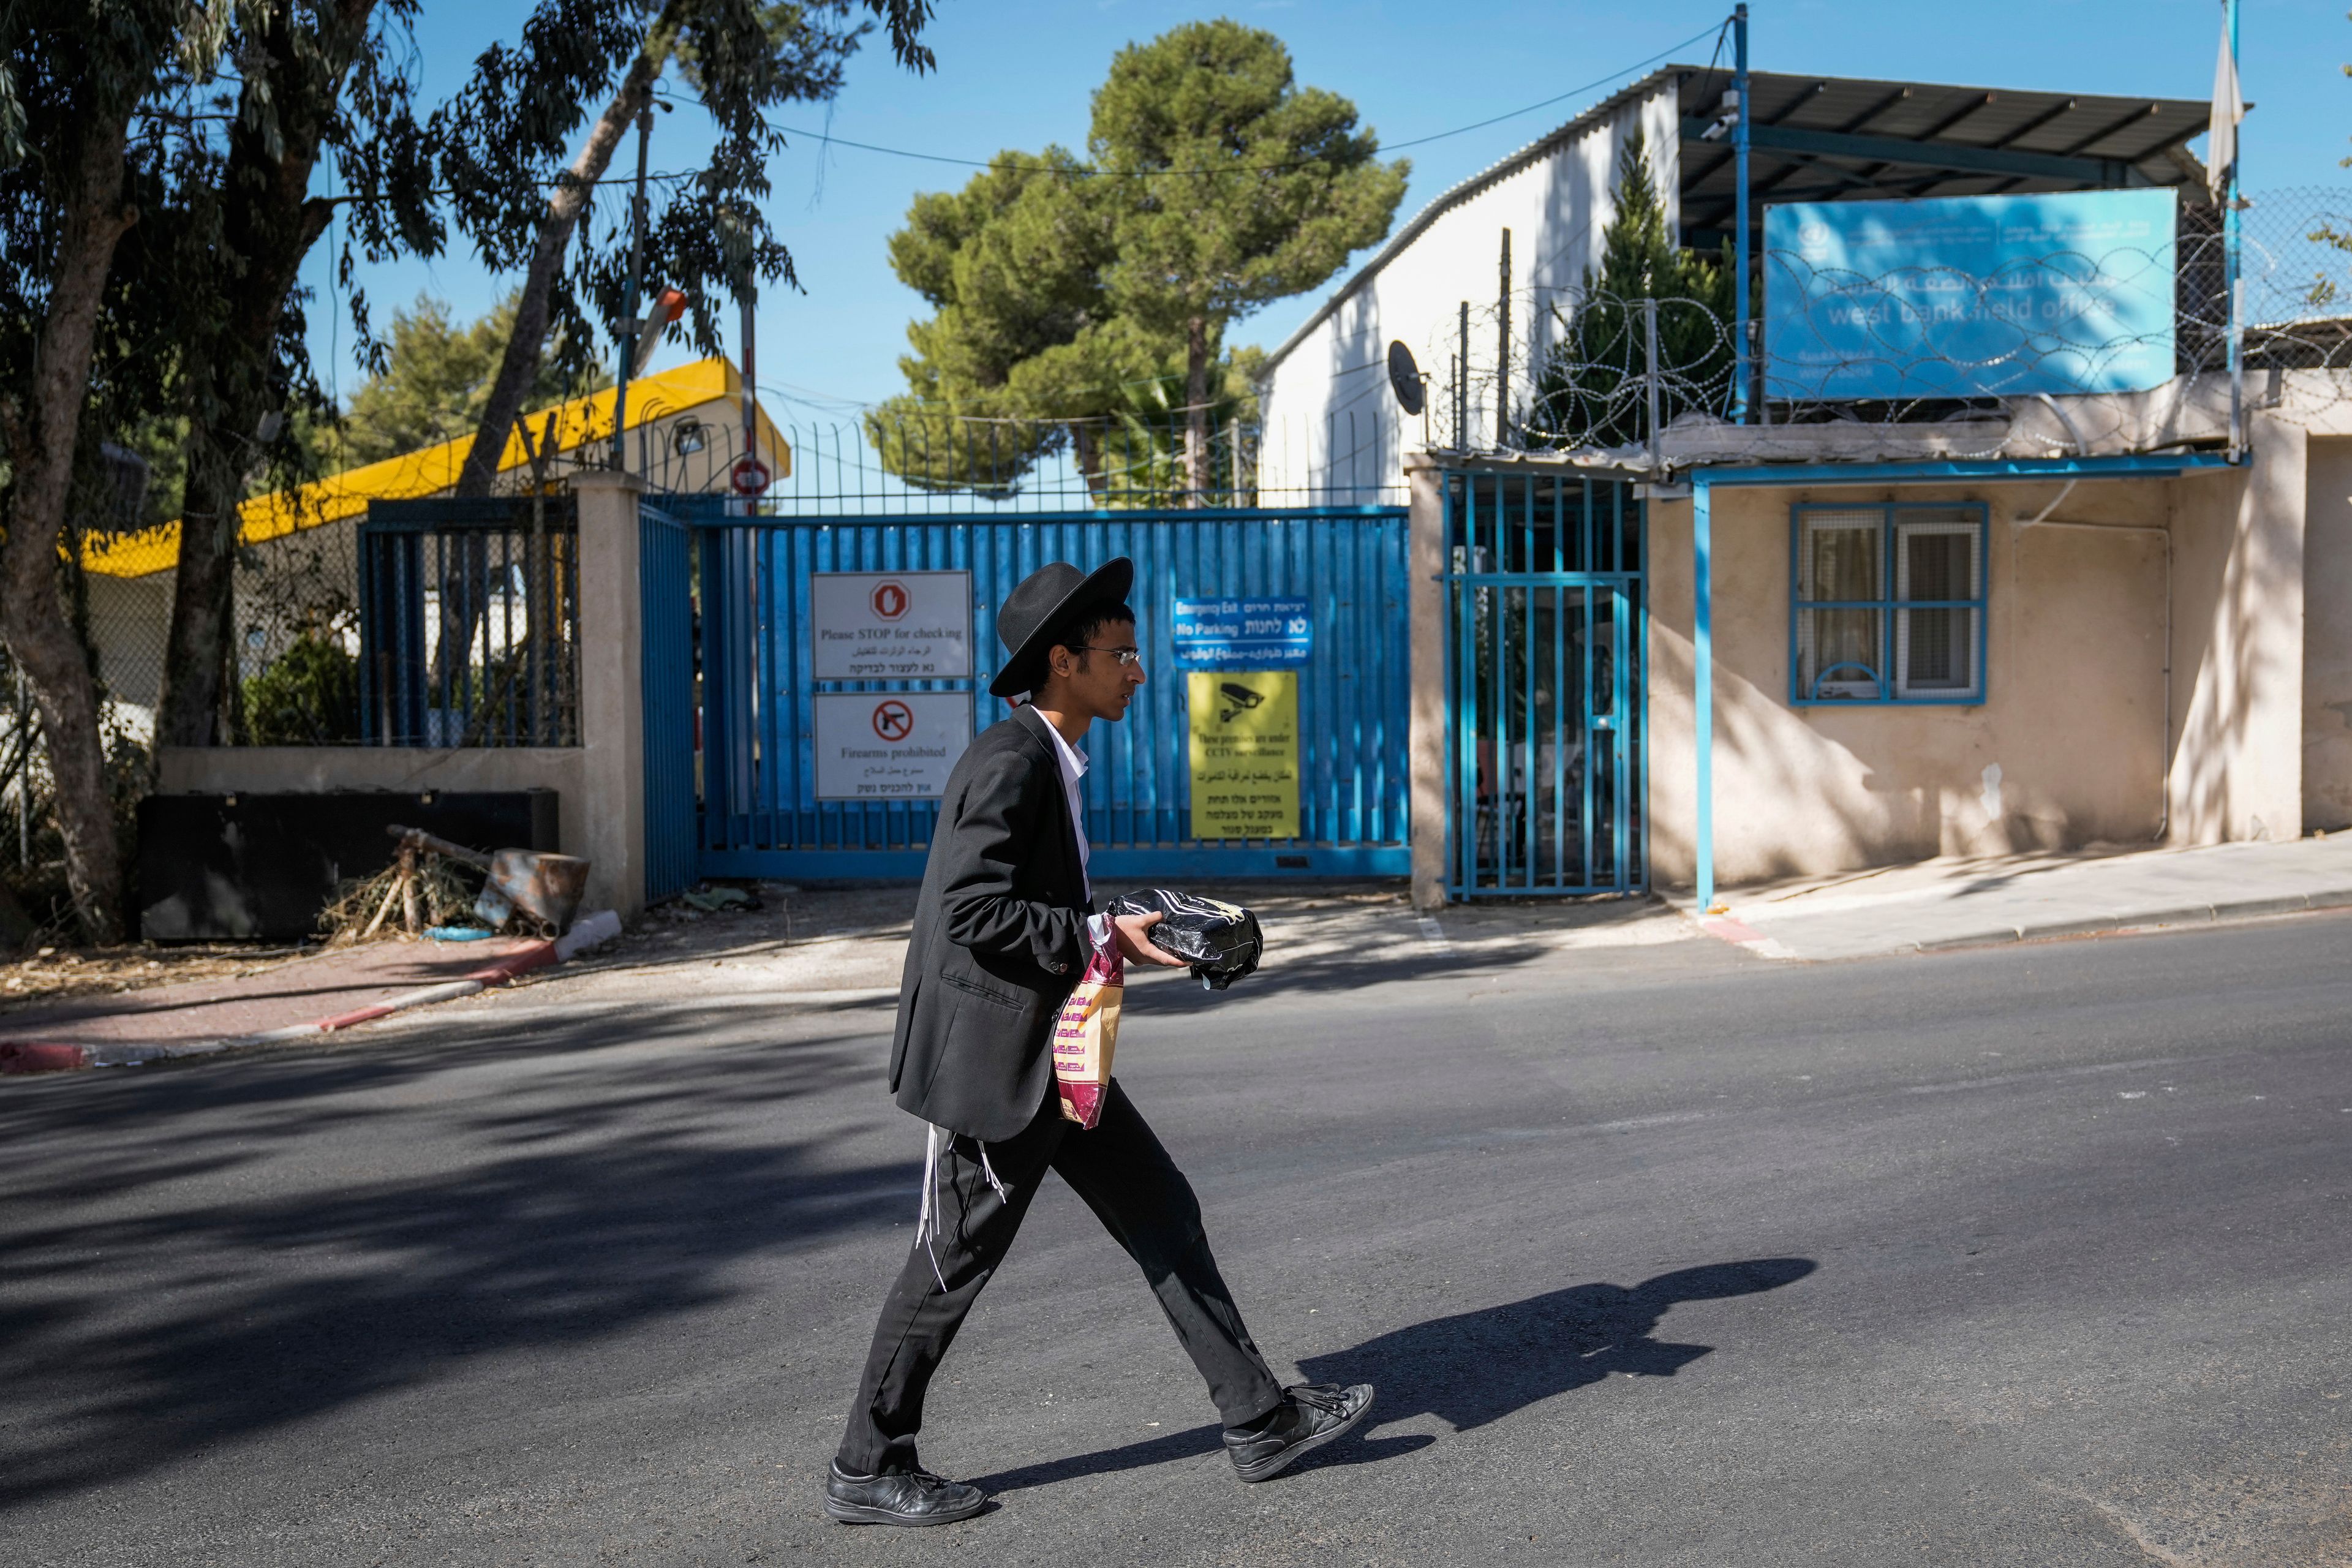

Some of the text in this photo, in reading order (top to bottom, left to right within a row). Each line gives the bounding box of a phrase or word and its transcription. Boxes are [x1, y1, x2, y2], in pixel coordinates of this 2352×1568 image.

[1828, 302, 1890, 325] west
[1901, 299, 1963, 323] bank
[2041, 293, 2116, 318] office
[1222, 601, 1238, 614] Exit
[1176, 622, 1239, 638] No Parking
[1245, 616, 1307, 635] לא לחנות
[821, 627, 962, 641] Please STOP for checking
[849, 662, 935, 674] נא לעצור לבדיקה
[1268, 733, 1291, 743] under
[841, 747, 946, 760] Firearms prohibited
[1205, 747, 1284, 757] CCTV surveillance
[858, 782, 931, 794] אין להכניס נשק
[1240, 809, 1254, 819] של
[1257, 810, 1283, 820] מעקב
